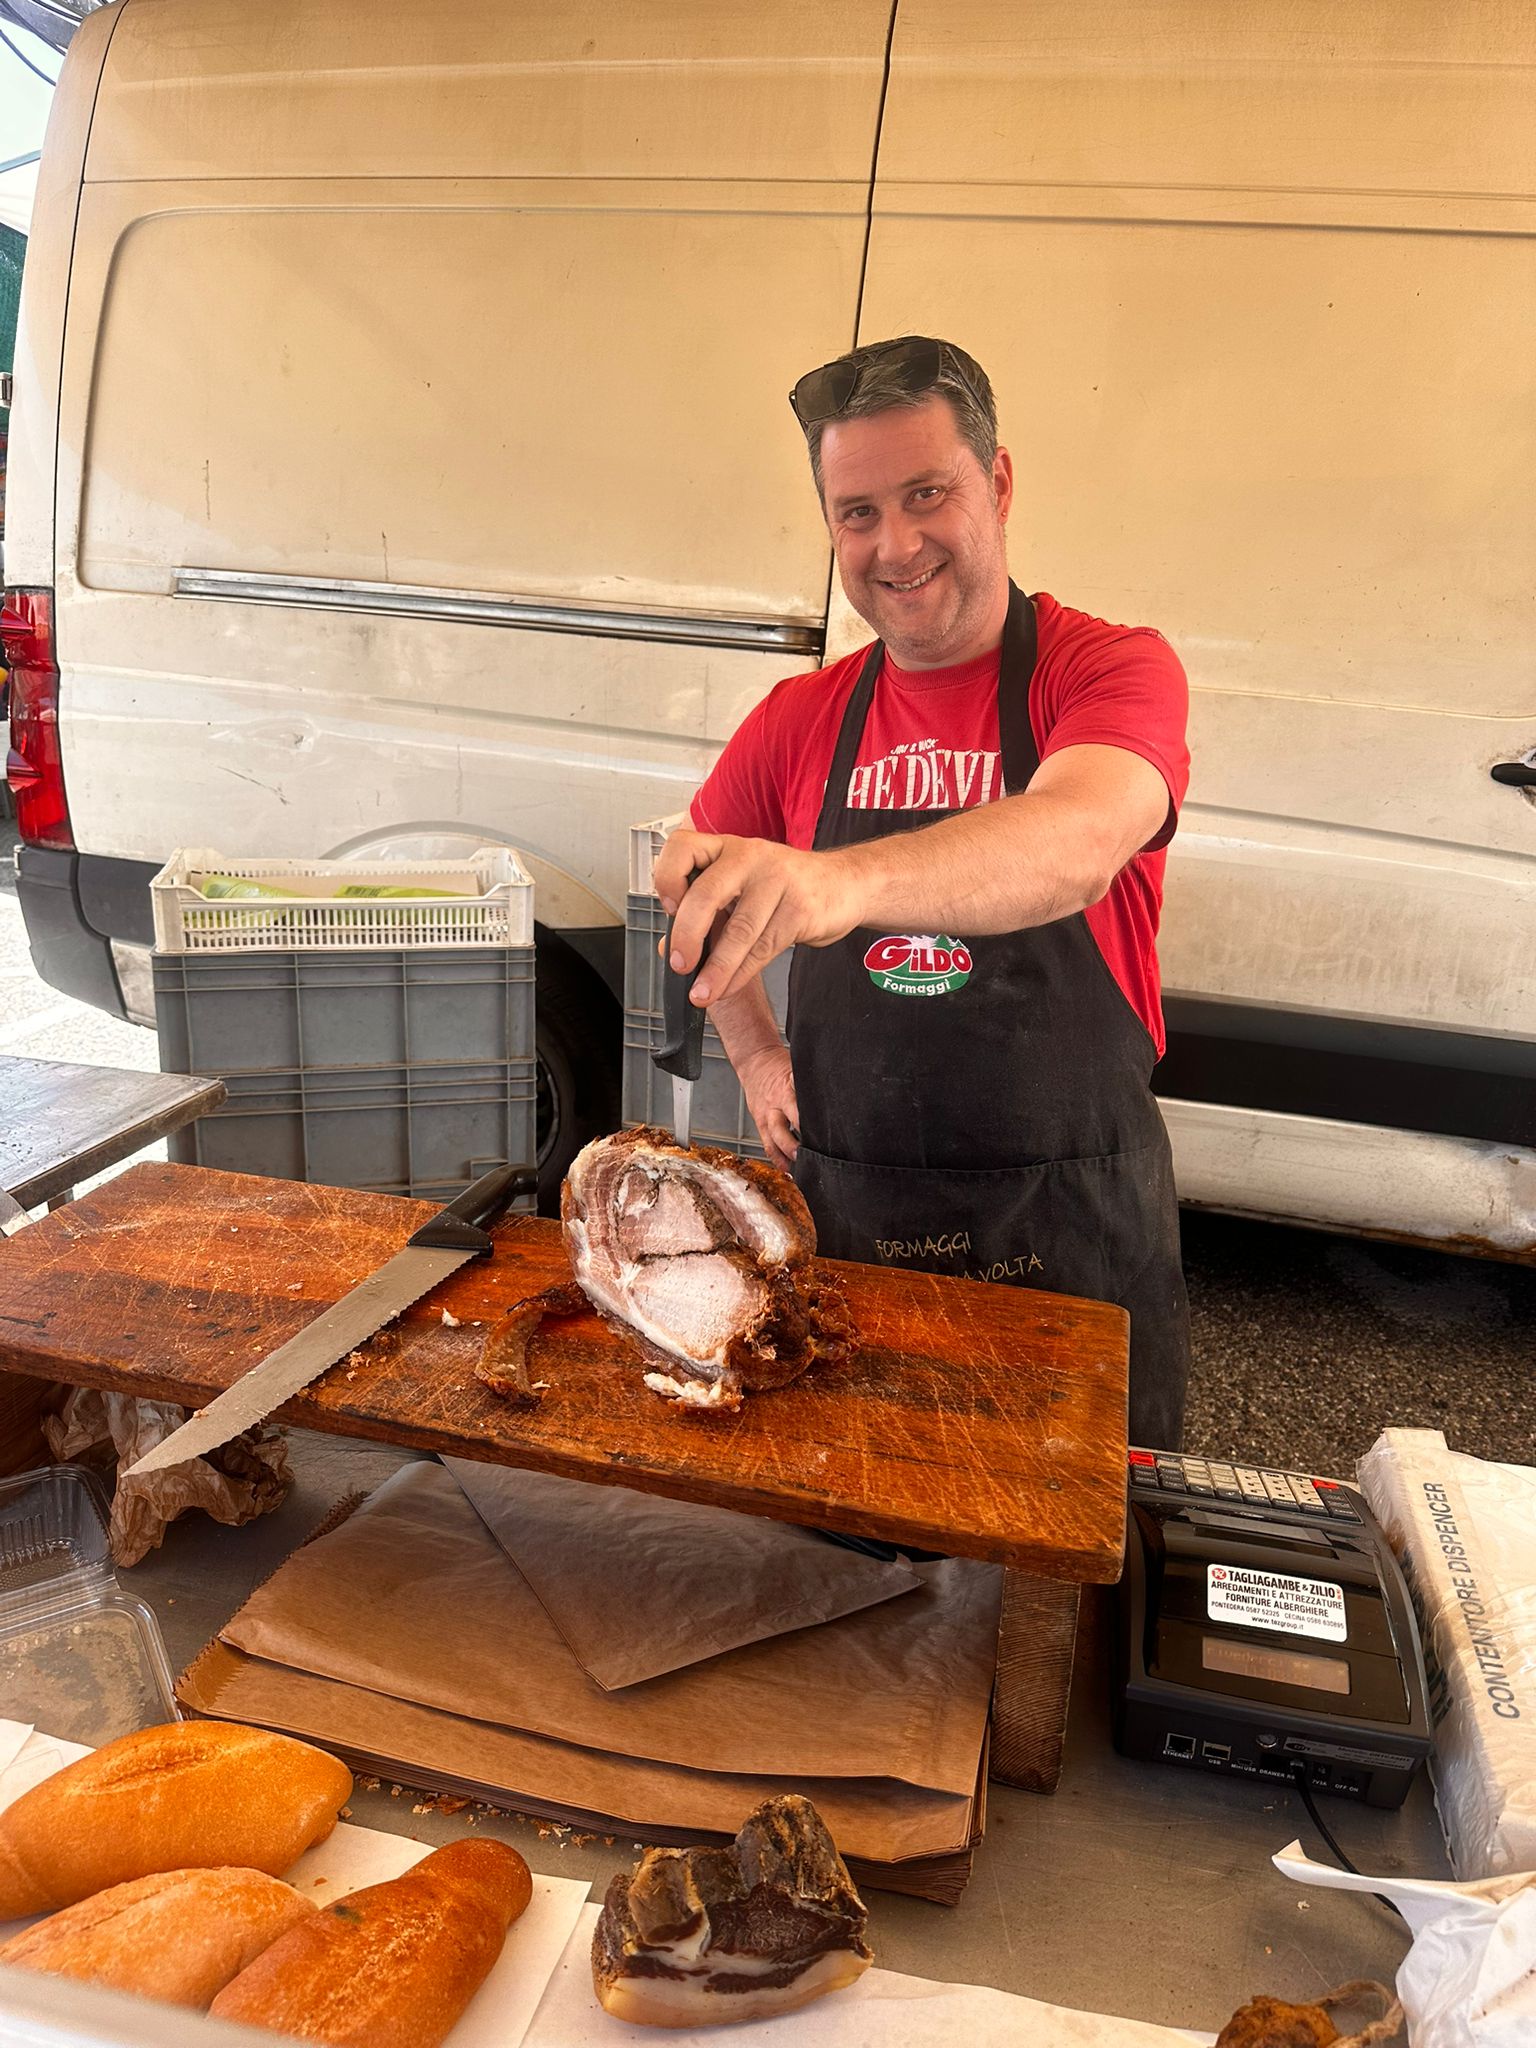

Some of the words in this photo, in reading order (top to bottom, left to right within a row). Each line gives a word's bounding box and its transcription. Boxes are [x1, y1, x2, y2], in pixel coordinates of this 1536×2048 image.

[847, 755, 899, 809] HE
[883, 978, 951, 996] Formaggi
[875, 1231, 972, 1259] FORMAGGI
[979, 1252, 1044, 1283] VOLTA
[1211, 1581, 1269, 1597] ARREDAMENTI
[1272, 1590, 1277, 1598] E
[1279, 1592, 1343, 1609] ATTREZZATURE
[1228, 1570, 1300, 1593] TAGLIAGAMBE
[1309, 1584, 1335, 1598] ZILIO
[1211, 1601, 1245, 1611] PONTEDERA
[1226, 1593, 1271, 1608] FORNITURE
[1274, 1600, 1329, 1617] ALBERGHIERE
[1453, 1575, 1521, 1720] CONTENITORE
[1162, 1750, 1193, 1760] ETHERNET
[1259, 1768, 1285, 1778] DRAWER
